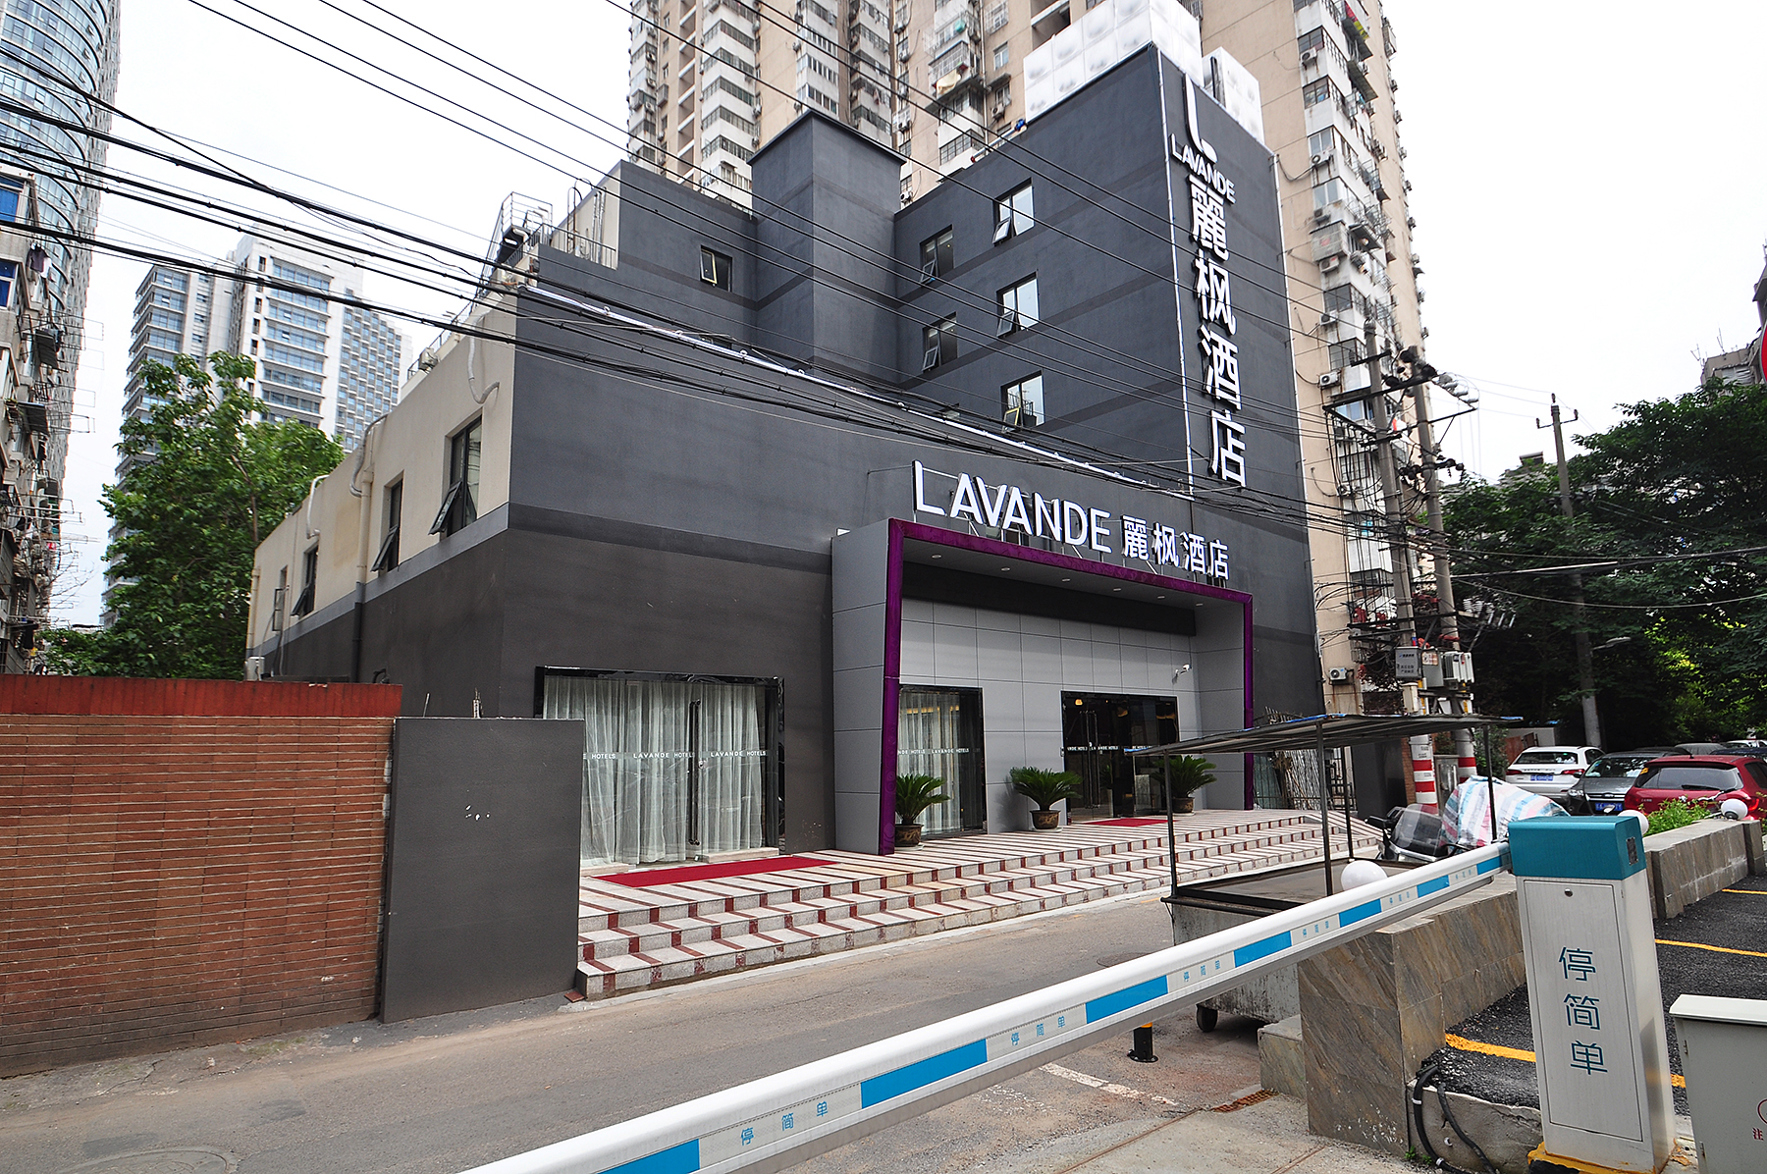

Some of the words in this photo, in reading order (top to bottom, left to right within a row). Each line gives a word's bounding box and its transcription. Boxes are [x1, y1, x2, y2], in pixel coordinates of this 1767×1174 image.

[1170, 133, 1236, 204] LAVANDE
[1187, 172, 1247, 488] 麗枫酒店
[912, 459, 1112, 554] LAVANDE
[1120, 514, 1229, 581] 麗枫酒店
[1010, 1015, 1066, 1046] 停简单
[1558, 946, 1608, 1076] 停简单
[740, 1101, 829, 1146] 停简单
